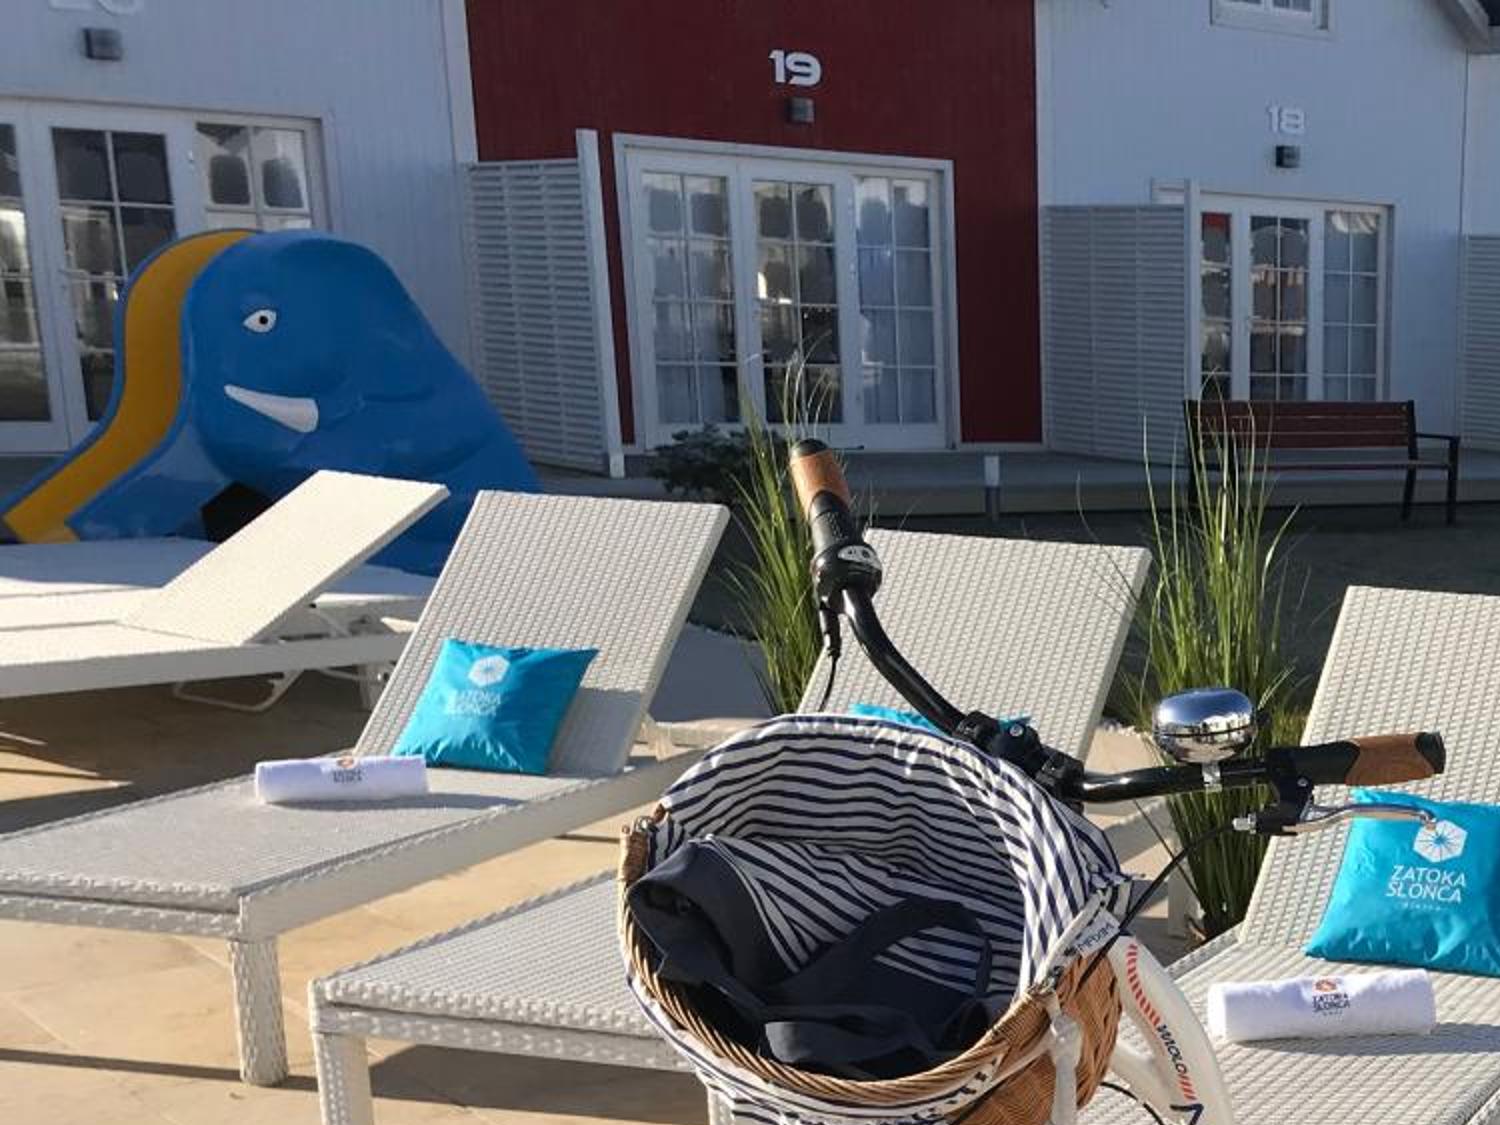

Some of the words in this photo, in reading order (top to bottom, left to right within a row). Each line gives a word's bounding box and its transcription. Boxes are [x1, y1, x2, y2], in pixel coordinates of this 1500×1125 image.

[768, 49, 822, 86] 19
[1267, 105, 1306, 134] 18
[1391, 863, 1467, 887] ZATOKA
